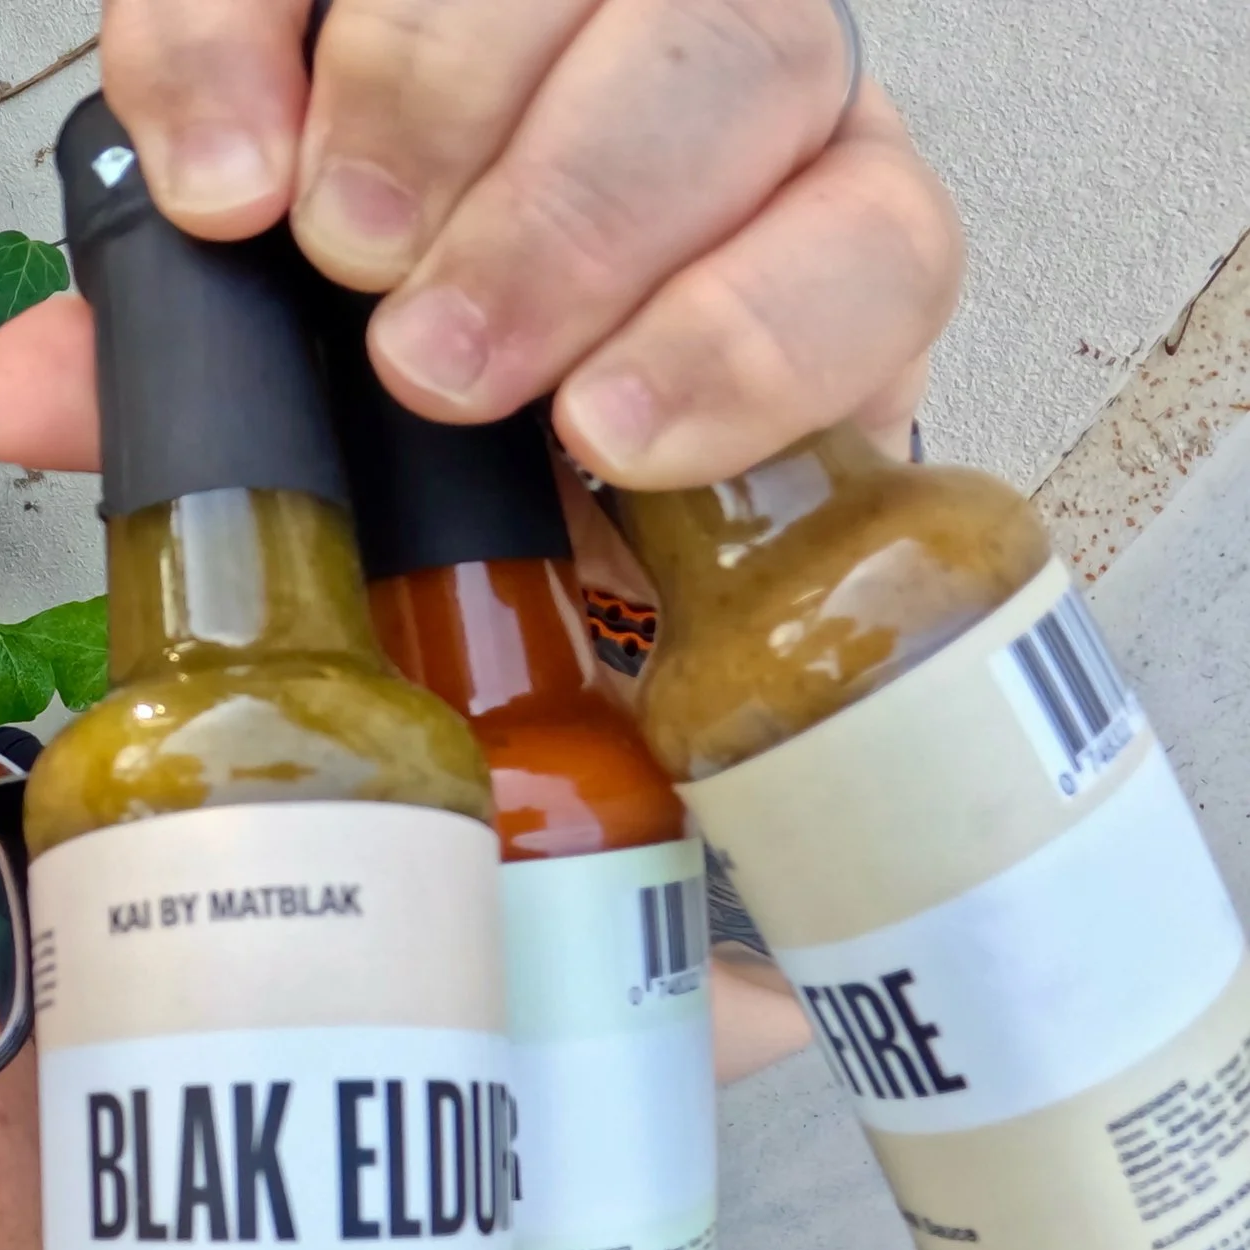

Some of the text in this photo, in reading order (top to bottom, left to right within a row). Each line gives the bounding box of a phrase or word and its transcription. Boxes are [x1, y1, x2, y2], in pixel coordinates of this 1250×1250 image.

[108, 883, 363, 936] KAI BY MATBLAK
[801, 968, 970, 1100] FIRE
[87, 1078, 523, 1243] BLAK ELDUR
